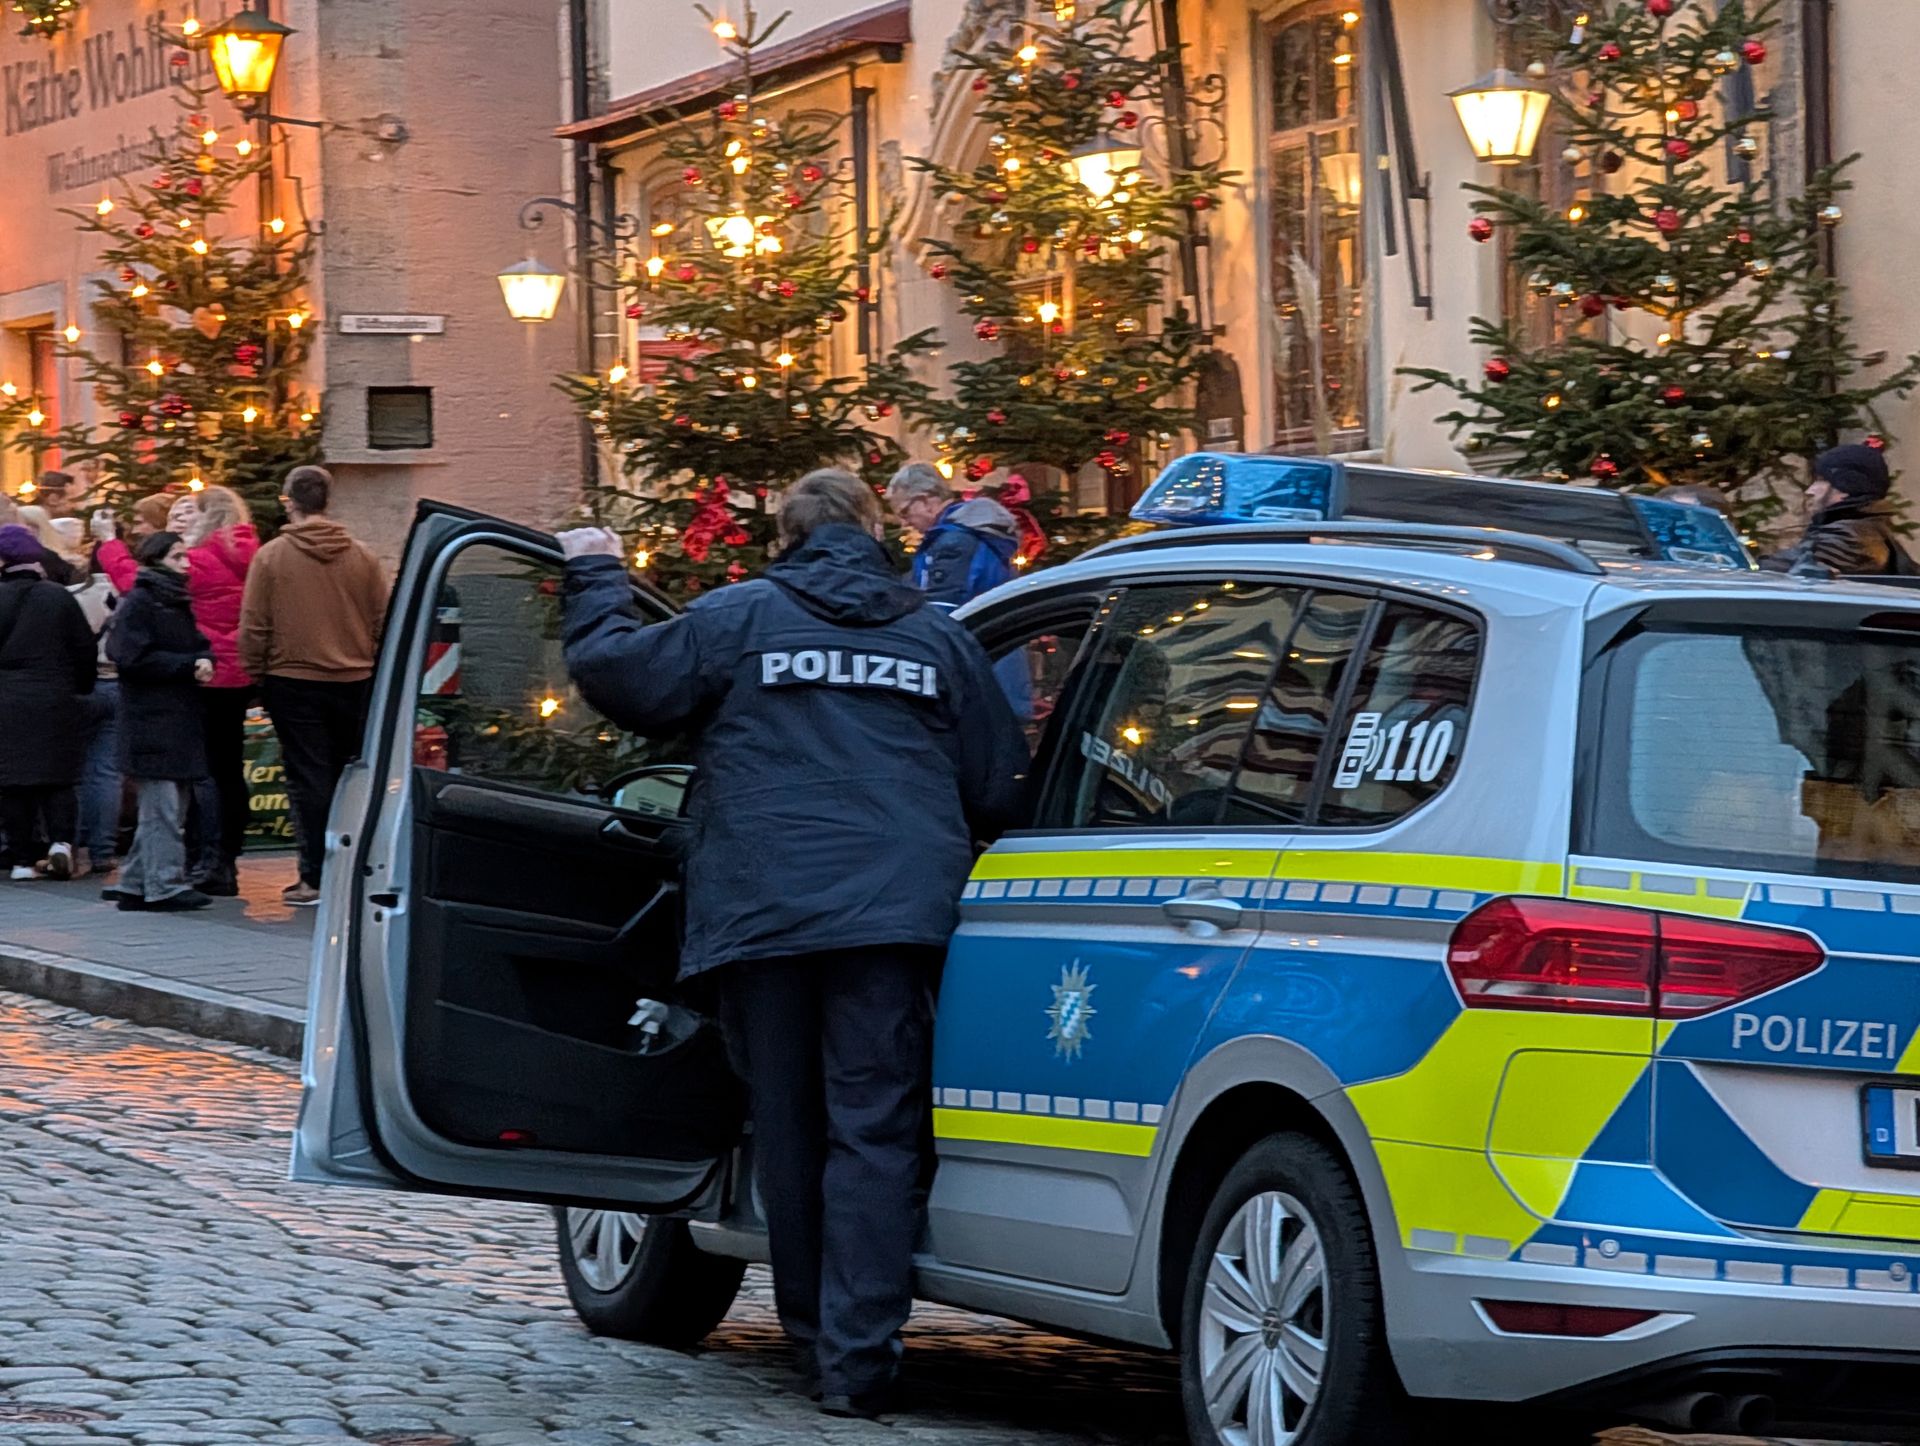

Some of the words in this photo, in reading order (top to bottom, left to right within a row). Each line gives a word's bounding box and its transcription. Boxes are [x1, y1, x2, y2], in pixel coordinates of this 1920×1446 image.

[761, 650, 937, 696] POLIZEI
[1374, 719, 1454, 782] 110
[1732, 1012, 1897, 1059] POLIZEI
